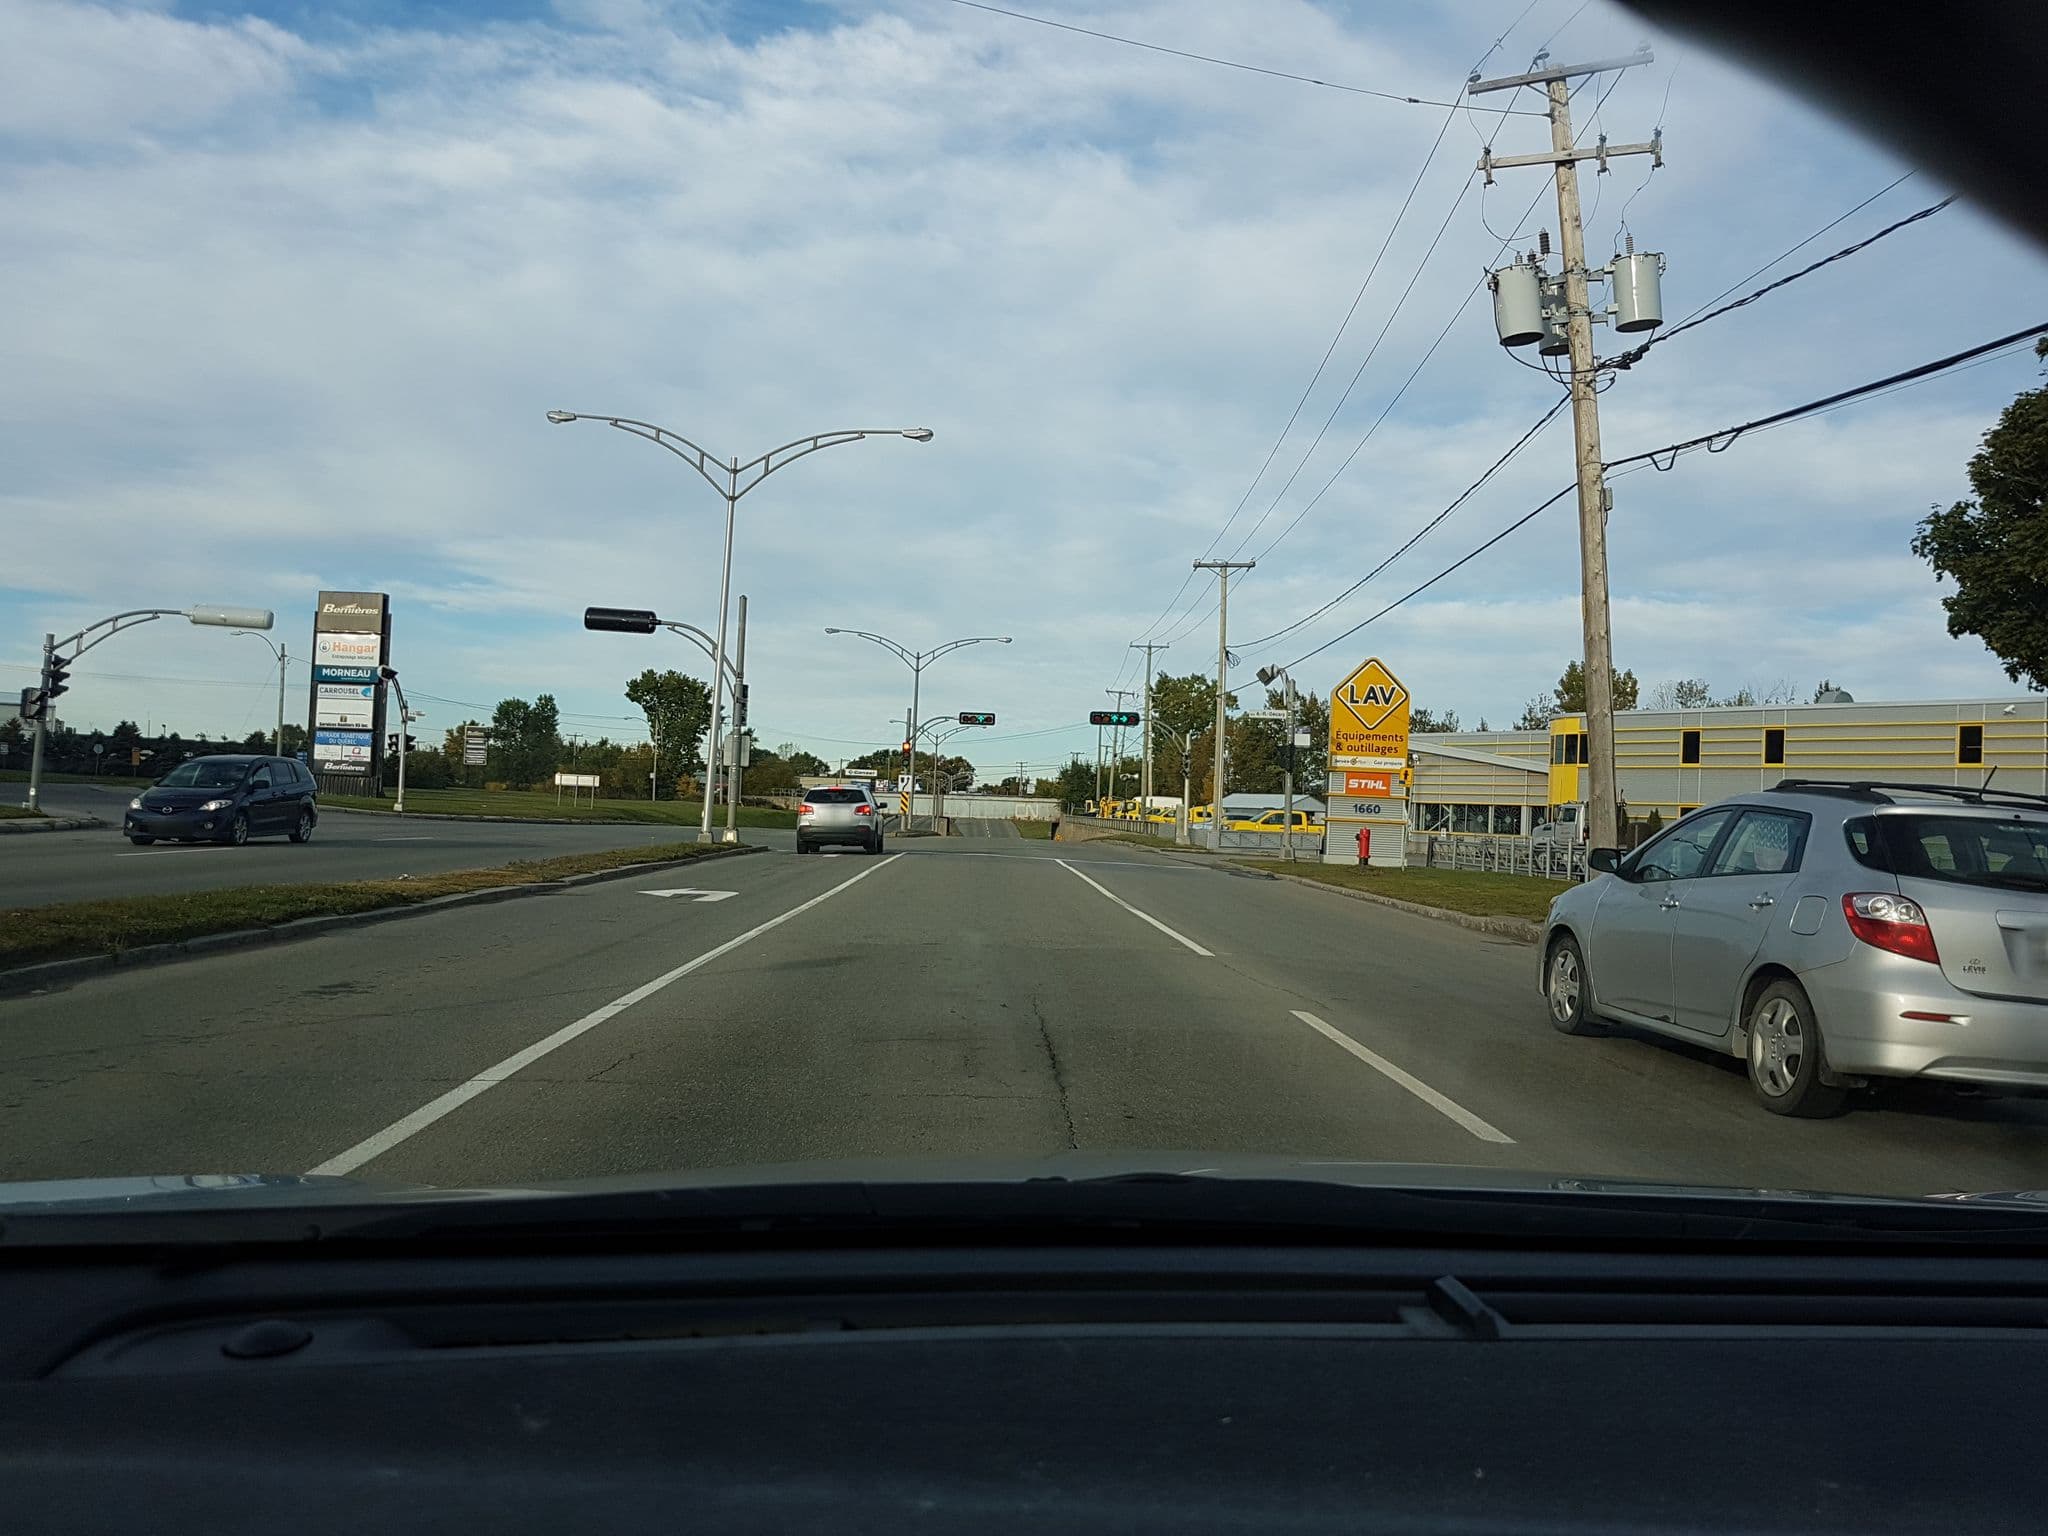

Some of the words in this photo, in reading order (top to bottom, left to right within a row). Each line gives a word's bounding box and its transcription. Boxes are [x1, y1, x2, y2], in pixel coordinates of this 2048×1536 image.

[323, 603, 379, 615] Bernières
[332, 641, 377, 654] Hangar
[322, 668, 371, 677] MORNEAU
[1348, 684, 1398, 706] LAV
[1335, 728, 1405, 742] Équipements
[1335, 742, 1344, 751] &
[1346, 743, 1399, 756] outillages
[1348, 779, 1387, 790] STIHL
[1352, 803, 1381, 814] 1660
